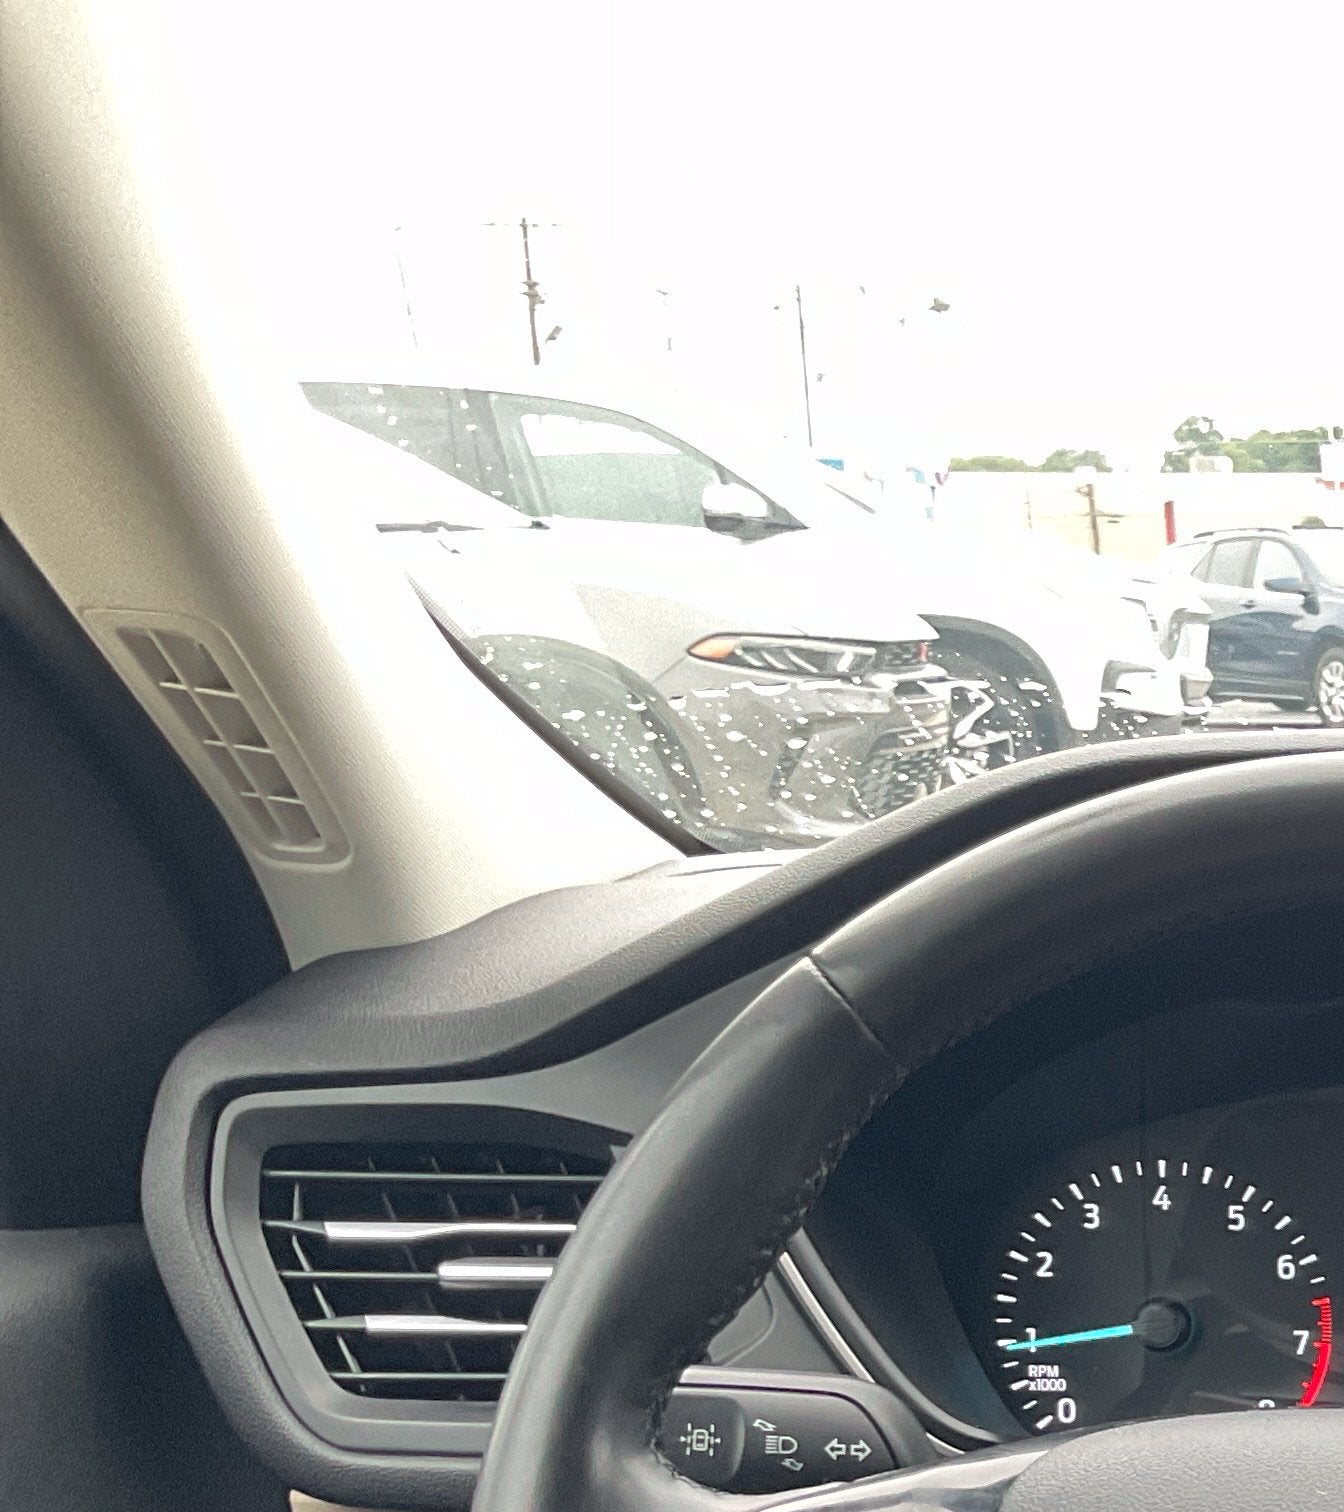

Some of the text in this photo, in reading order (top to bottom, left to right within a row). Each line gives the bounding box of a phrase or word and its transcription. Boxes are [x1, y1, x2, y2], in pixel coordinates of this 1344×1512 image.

[1152, 1185, 1172, 1211] 4
[1083, 1203, 1100, 1230] 3
[1227, 1205, 1246, 1231] 5
[1035, 1251, 1054, 1278] 2
[1276, 1254, 1296, 1281] 6
[1292, 1330, 1310, 1355] 7
[1027, 1364, 1060, 1378] RPM
[1028, 1378, 1067, 1392] x1000
[1056, 1397, 1077, 1424] 0
